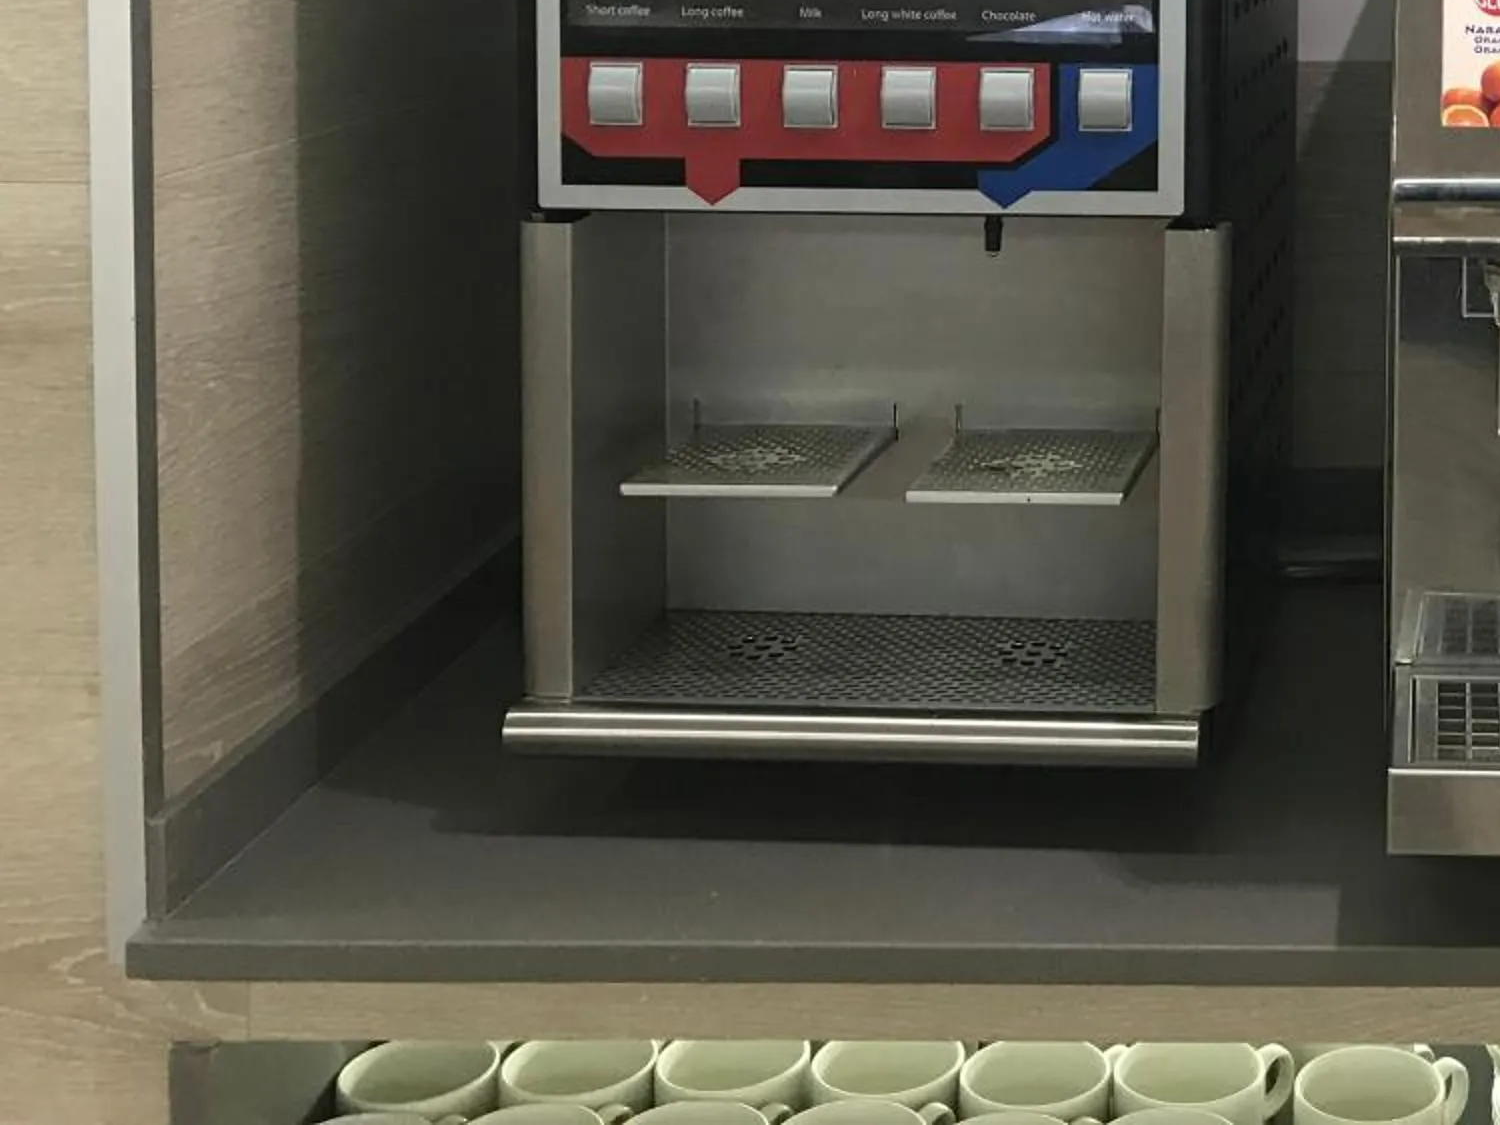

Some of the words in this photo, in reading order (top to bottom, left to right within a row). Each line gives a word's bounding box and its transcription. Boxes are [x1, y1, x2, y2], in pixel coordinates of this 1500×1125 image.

[681, 5, 708, 20] Long
[709, 5, 744, 18] coffee
[861, 8, 890, 23] Long
